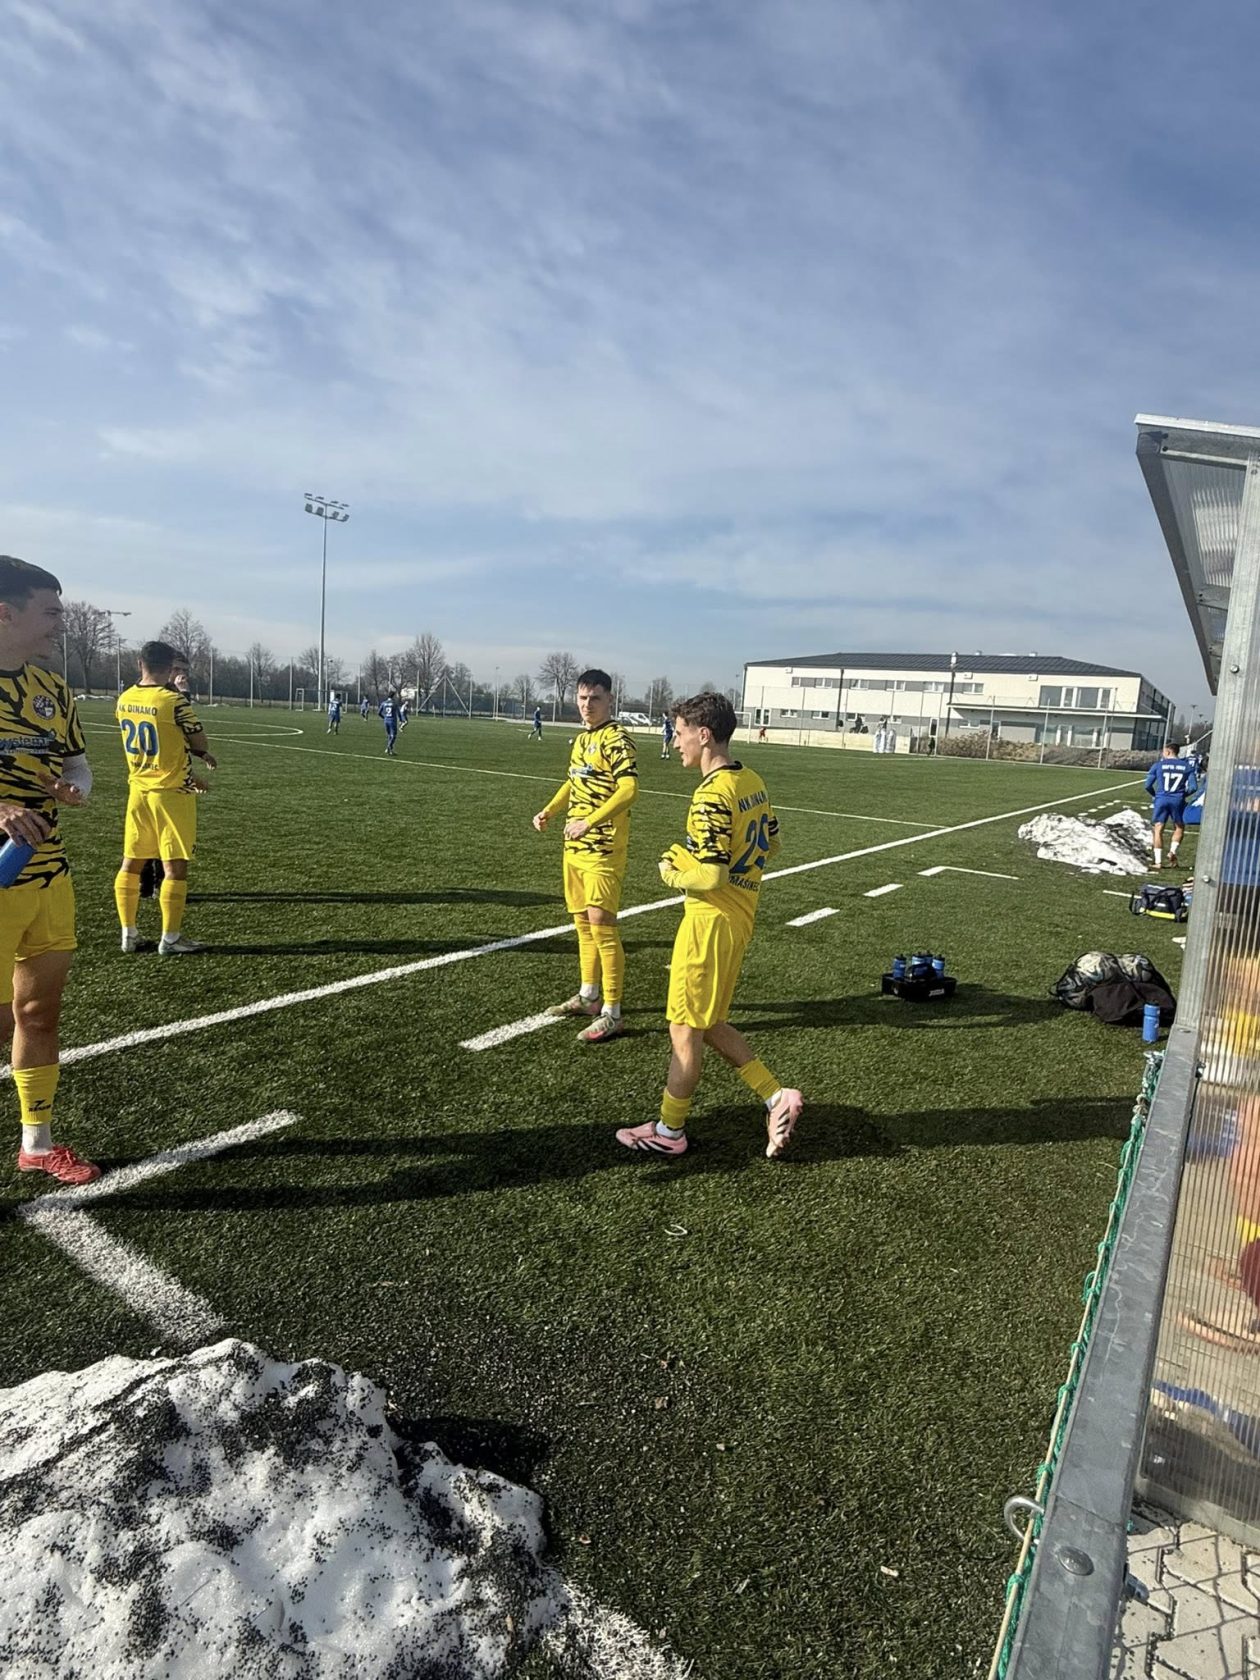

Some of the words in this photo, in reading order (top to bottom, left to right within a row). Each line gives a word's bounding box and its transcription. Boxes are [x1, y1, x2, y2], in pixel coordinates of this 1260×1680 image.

[127, 704, 158, 717] DINAMO
[121, 718, 159, 757] 20
[1162, 772, 1184, 793] 17
